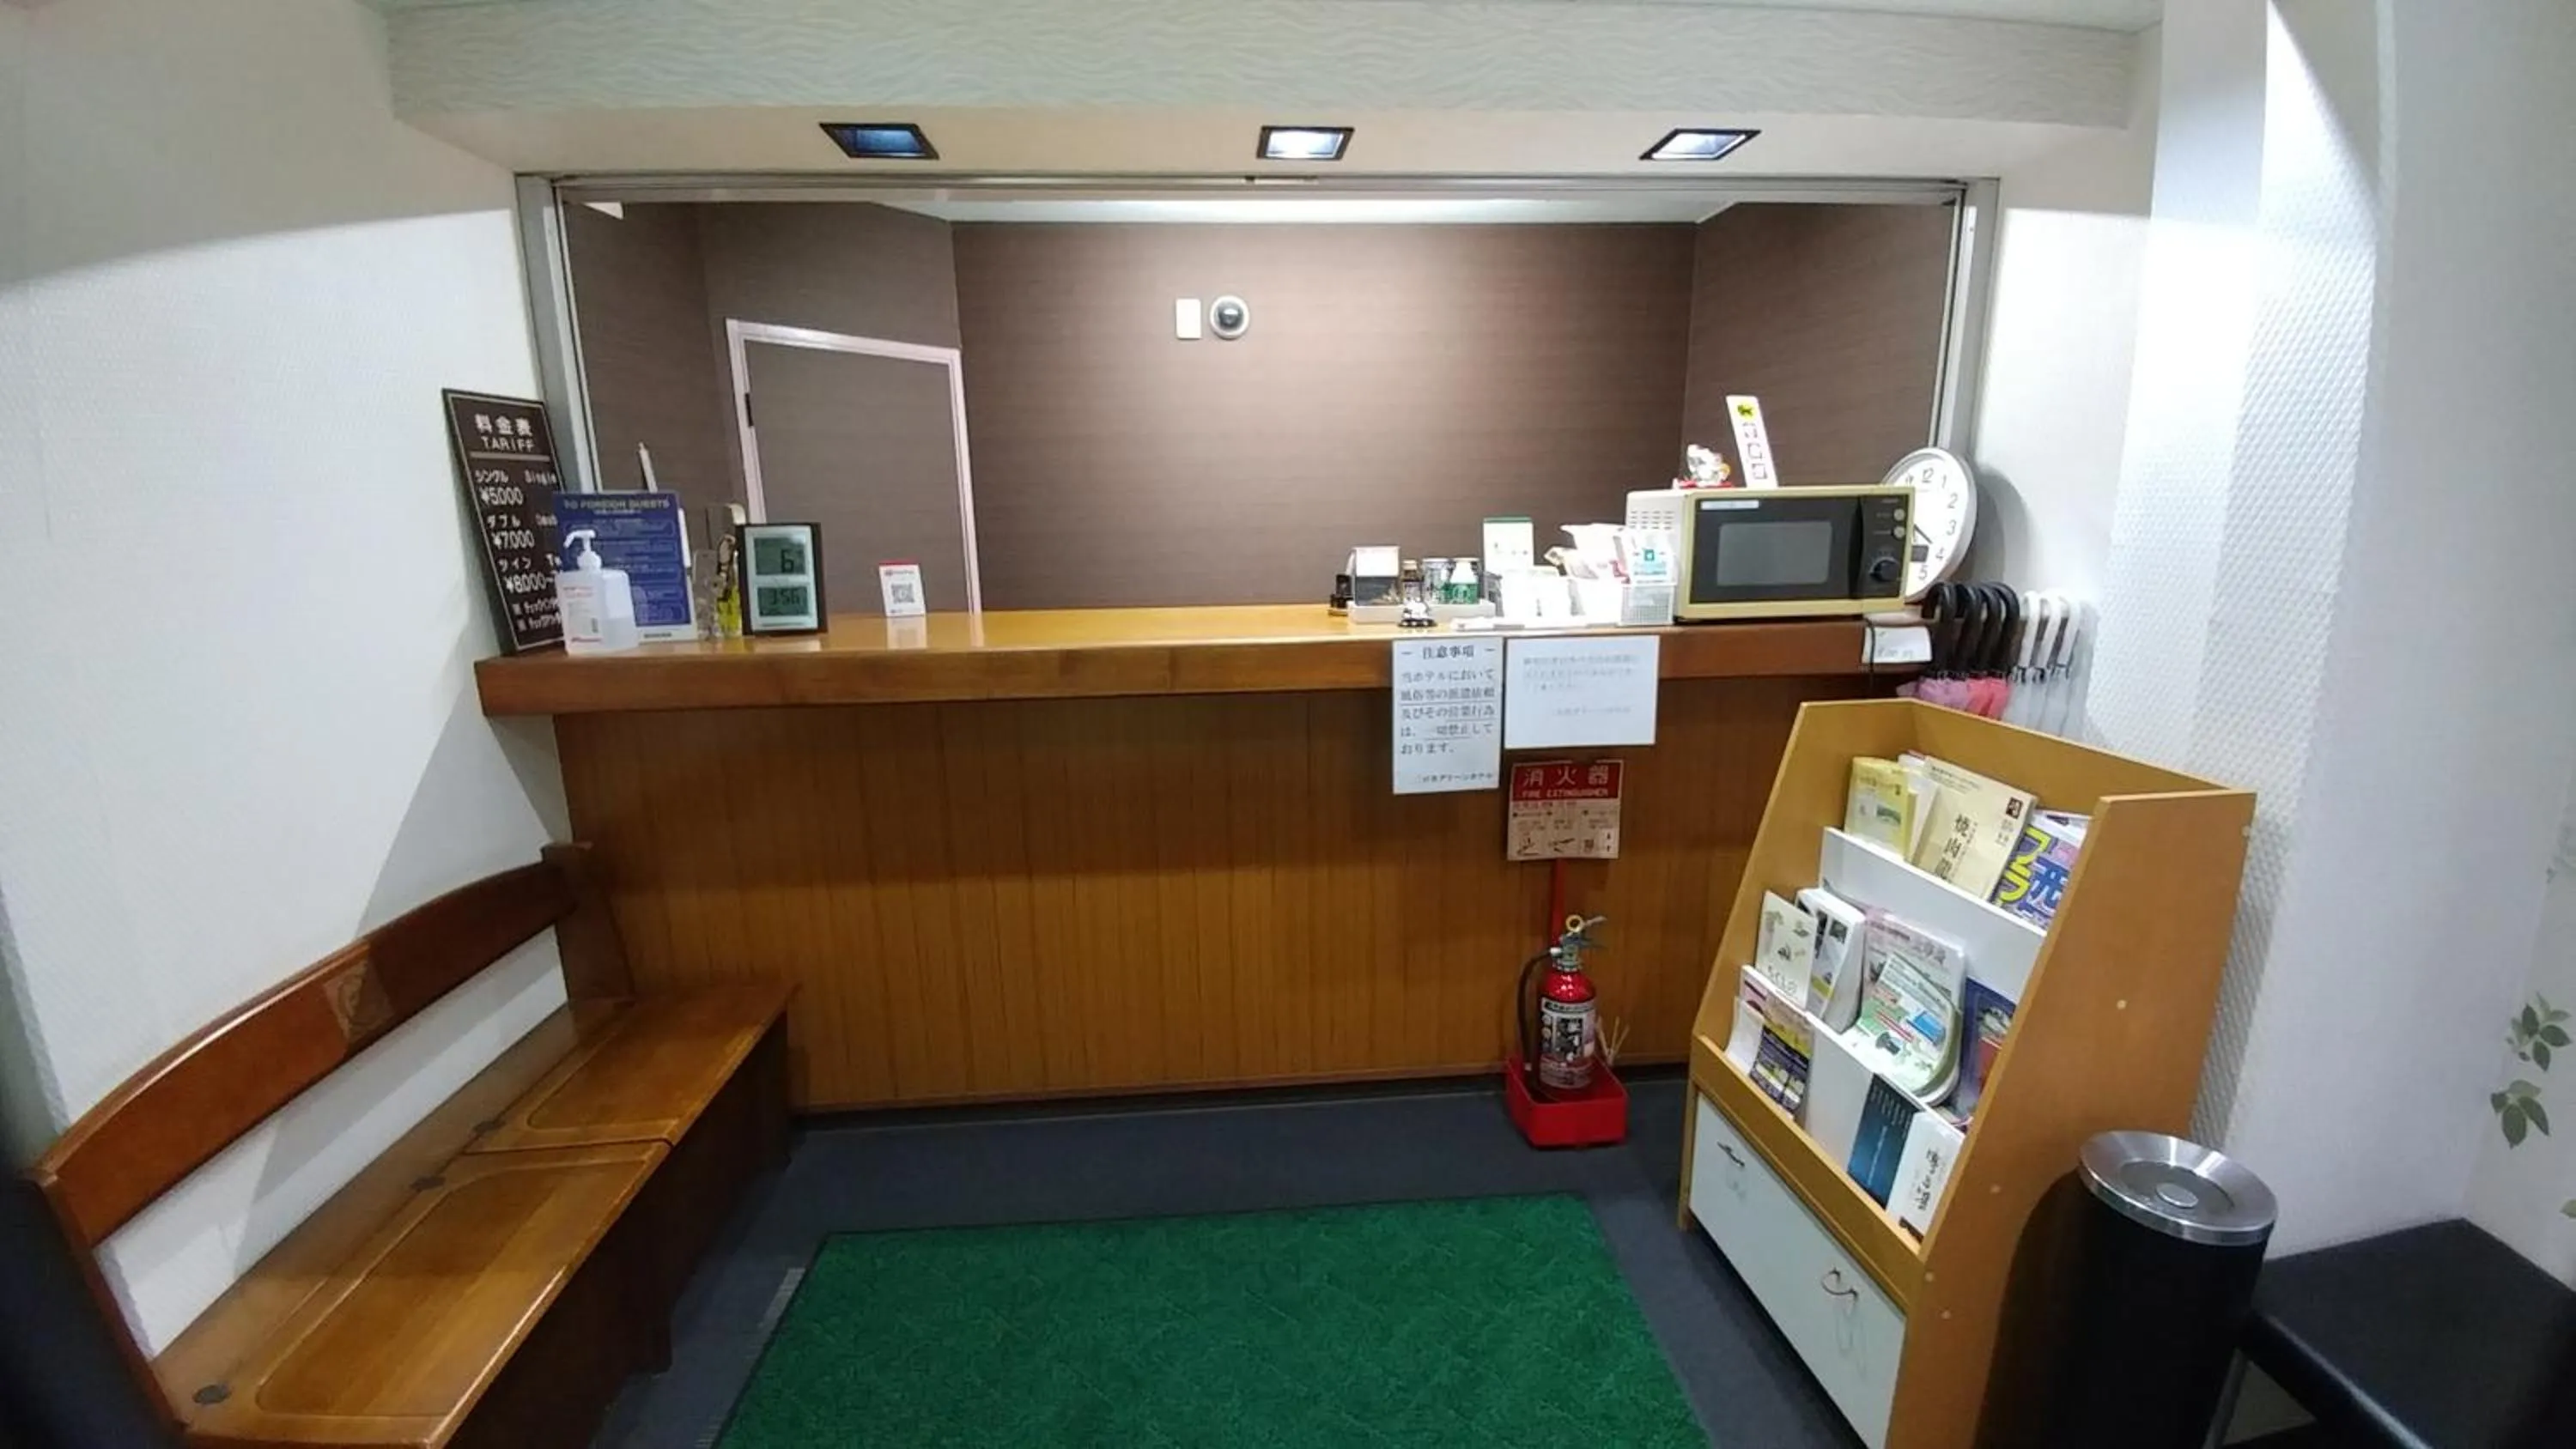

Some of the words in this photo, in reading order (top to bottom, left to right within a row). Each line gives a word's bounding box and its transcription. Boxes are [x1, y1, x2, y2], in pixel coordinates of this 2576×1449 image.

[475, 414, 532, 436] 料金表
[481, 435, 534, 452] TARIFF
[1922, 468, 1934, 483] 12
[1947, 493, 1959, 509] 2
[1946, 519, 1957, 537] 3
[1918, 564, 1929, 581] 5
[1522, 765, 1609, 787] 消火器
